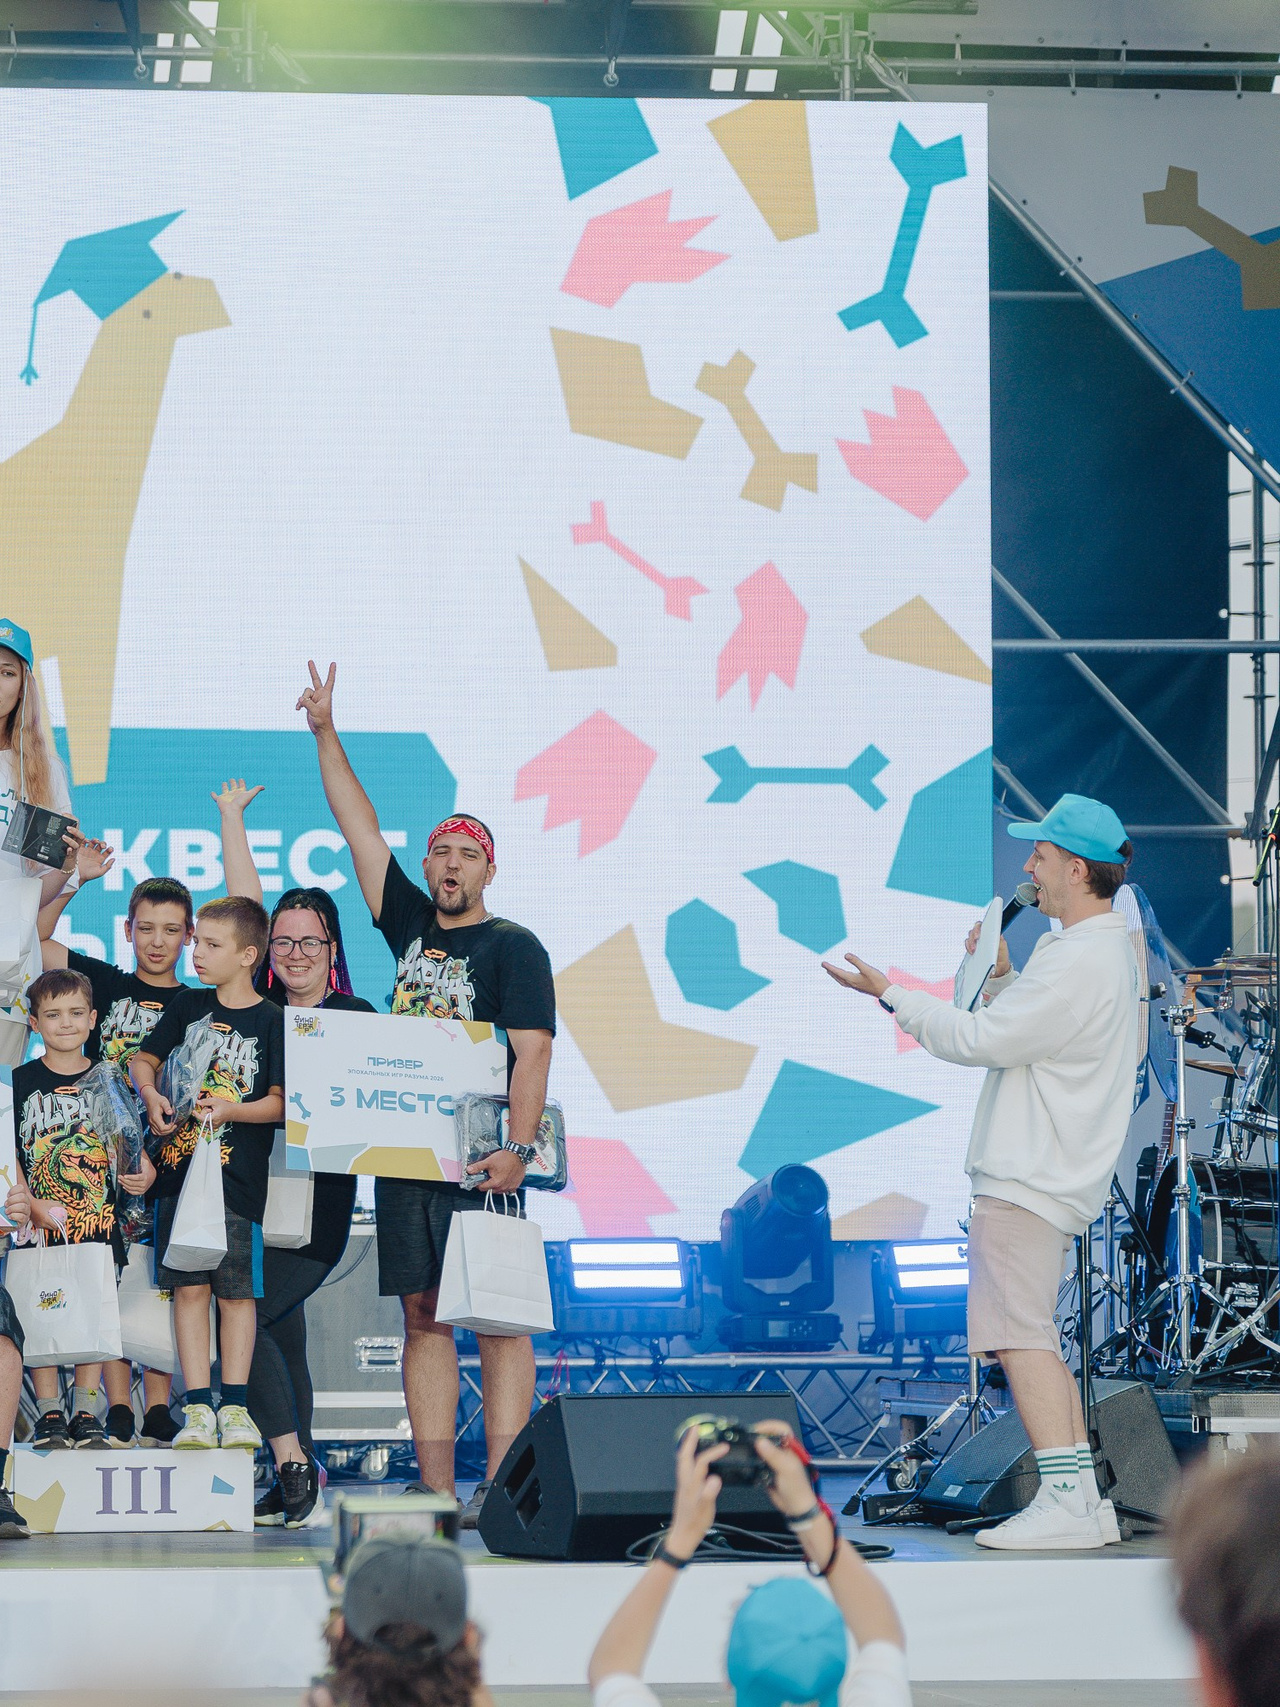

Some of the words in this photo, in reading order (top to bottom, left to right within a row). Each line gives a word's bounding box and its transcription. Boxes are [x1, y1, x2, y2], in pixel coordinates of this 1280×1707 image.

[367, 1056, 424, 1070] ПРИЗЕР
[347, 1068, 390, 1077] ЭПОХАЛЬНЫХ
[330, 1086, 346, 1107] 3
[95, 1466, 178, 1515] III
